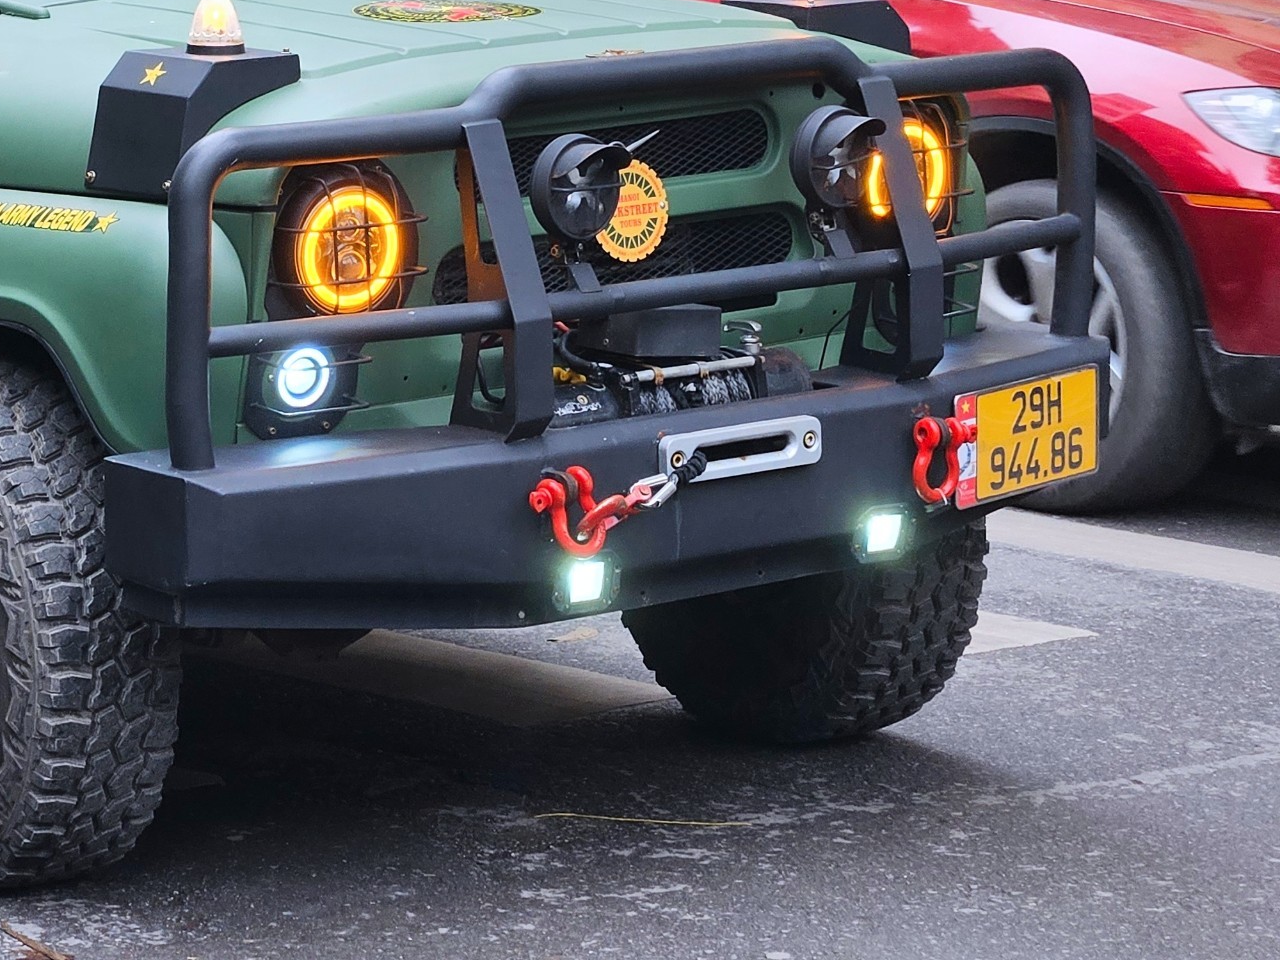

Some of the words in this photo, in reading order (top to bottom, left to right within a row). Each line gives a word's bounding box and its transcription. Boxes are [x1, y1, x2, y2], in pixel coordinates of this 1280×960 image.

[34, 206, 97, 232] LEGEND
[619, 218, 642, 229] TOURS
[1012, 381, 1062, 435] 29H
[990, 427, 1083, 490] 944.86
